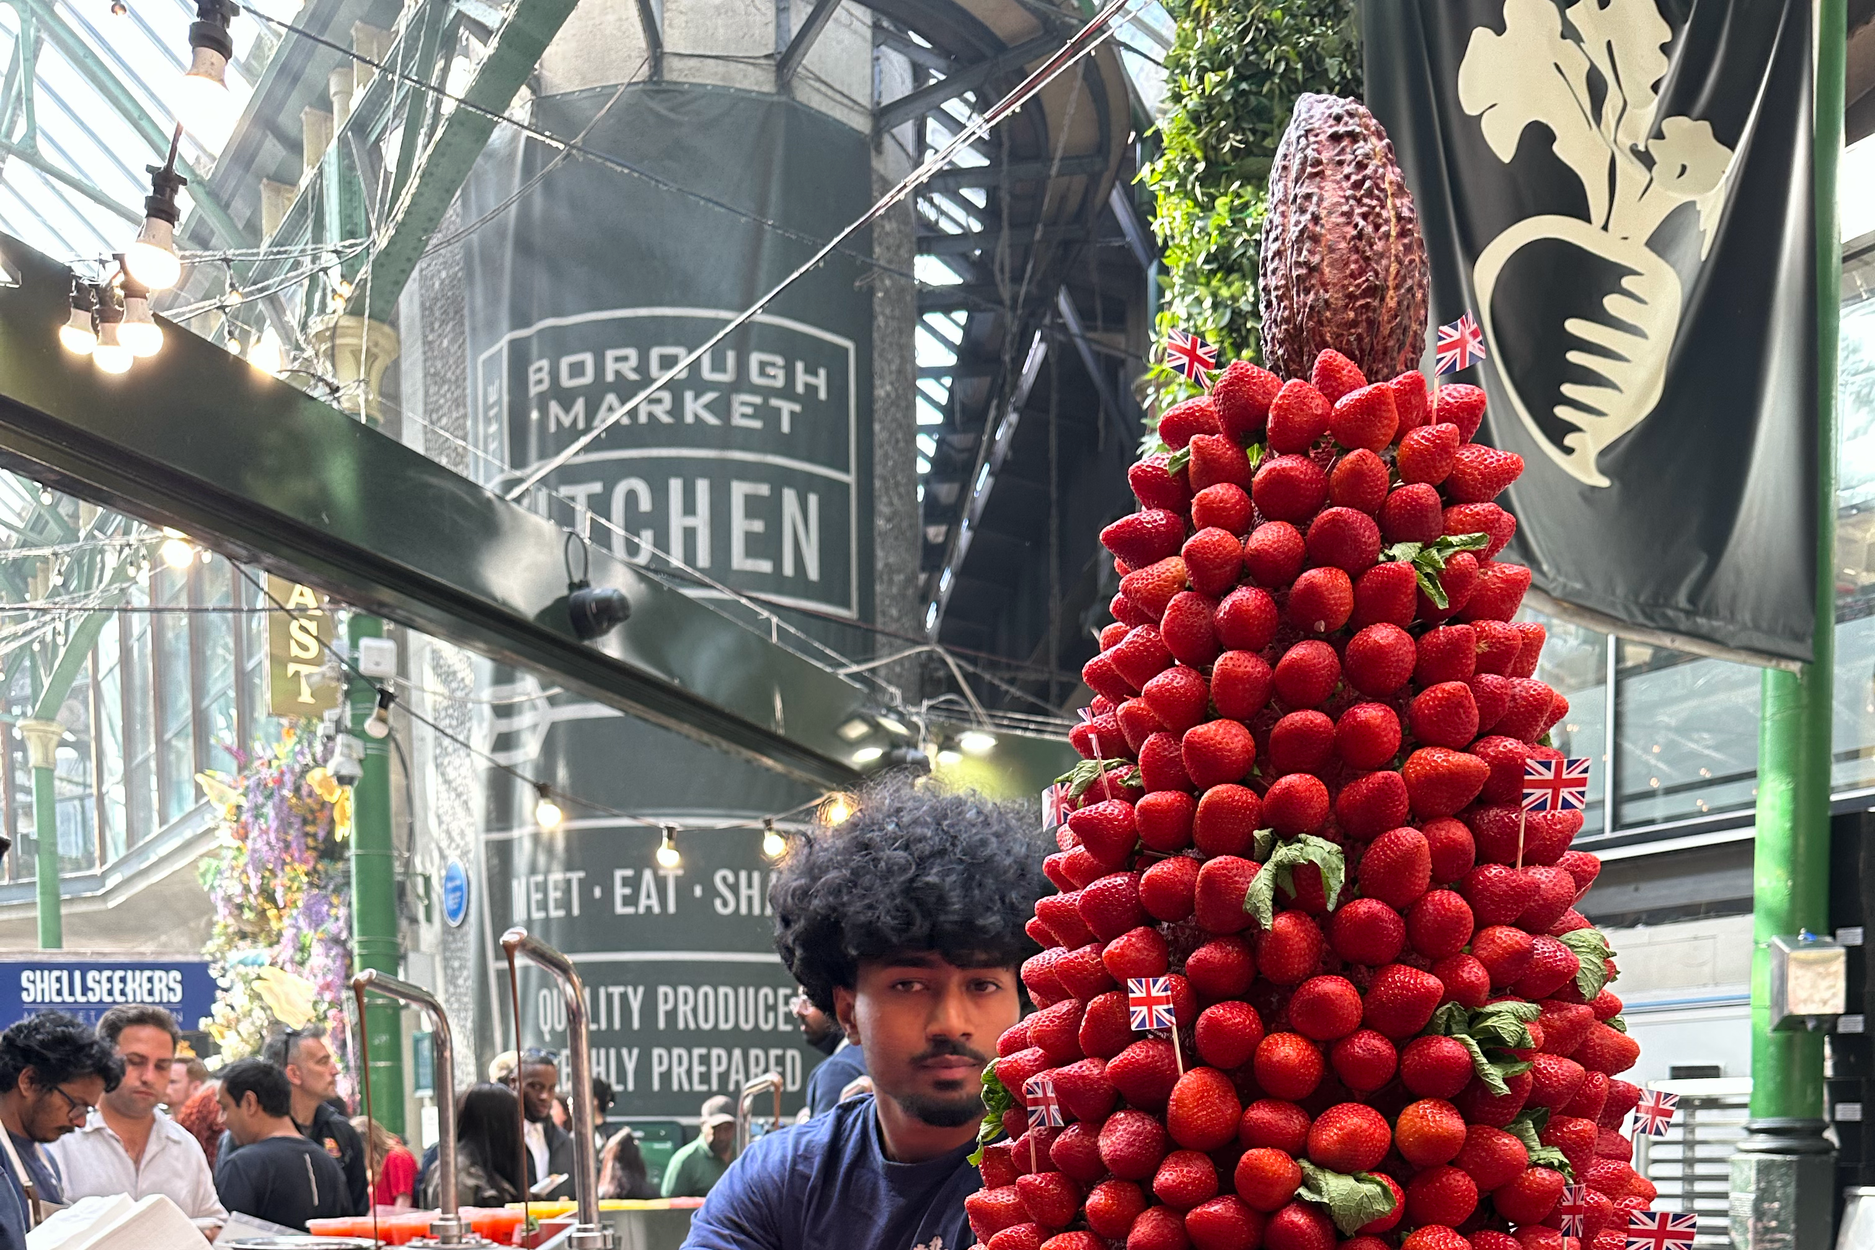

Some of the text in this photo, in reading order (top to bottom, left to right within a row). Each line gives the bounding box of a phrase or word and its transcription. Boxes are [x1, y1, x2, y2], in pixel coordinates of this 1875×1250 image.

[527, 345, 829, 400] BOROUGH
[547, 389, 802, 434] MARKET
[511, 870, 586, 924] MEET
[613, 867, 684, 915] EAT
[20, 969, 183, 1003] SHELLSEEKERS
[538, 985, 794, 1042] QULITY PRODUCE
[651, 1046, 802, 1092] PREPARED
